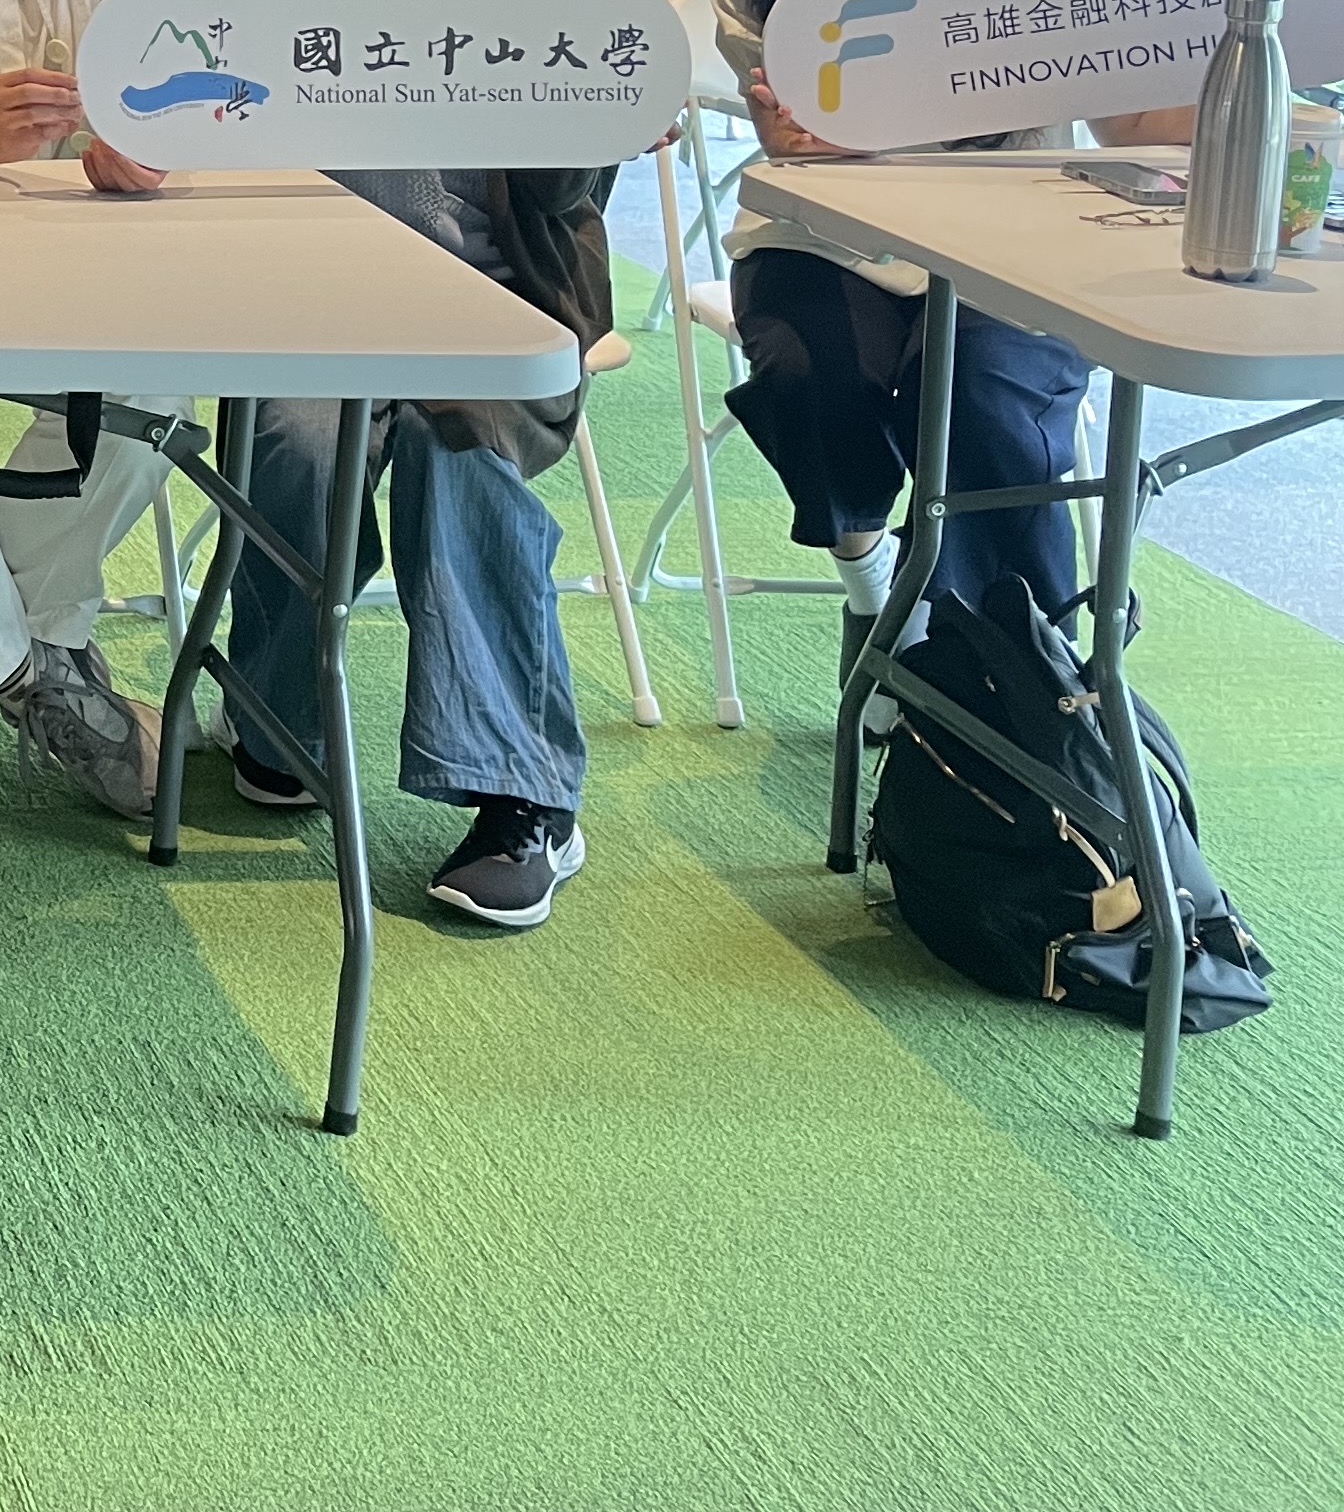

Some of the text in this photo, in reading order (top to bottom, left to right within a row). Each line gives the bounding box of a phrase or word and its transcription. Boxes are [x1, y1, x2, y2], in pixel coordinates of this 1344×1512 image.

[293, 23, 650, 77] 國立中山大學
[950, 41, 1175, 94] FINNOVATION
[295, 81, 644, 106] National Sun Yat-sen University
